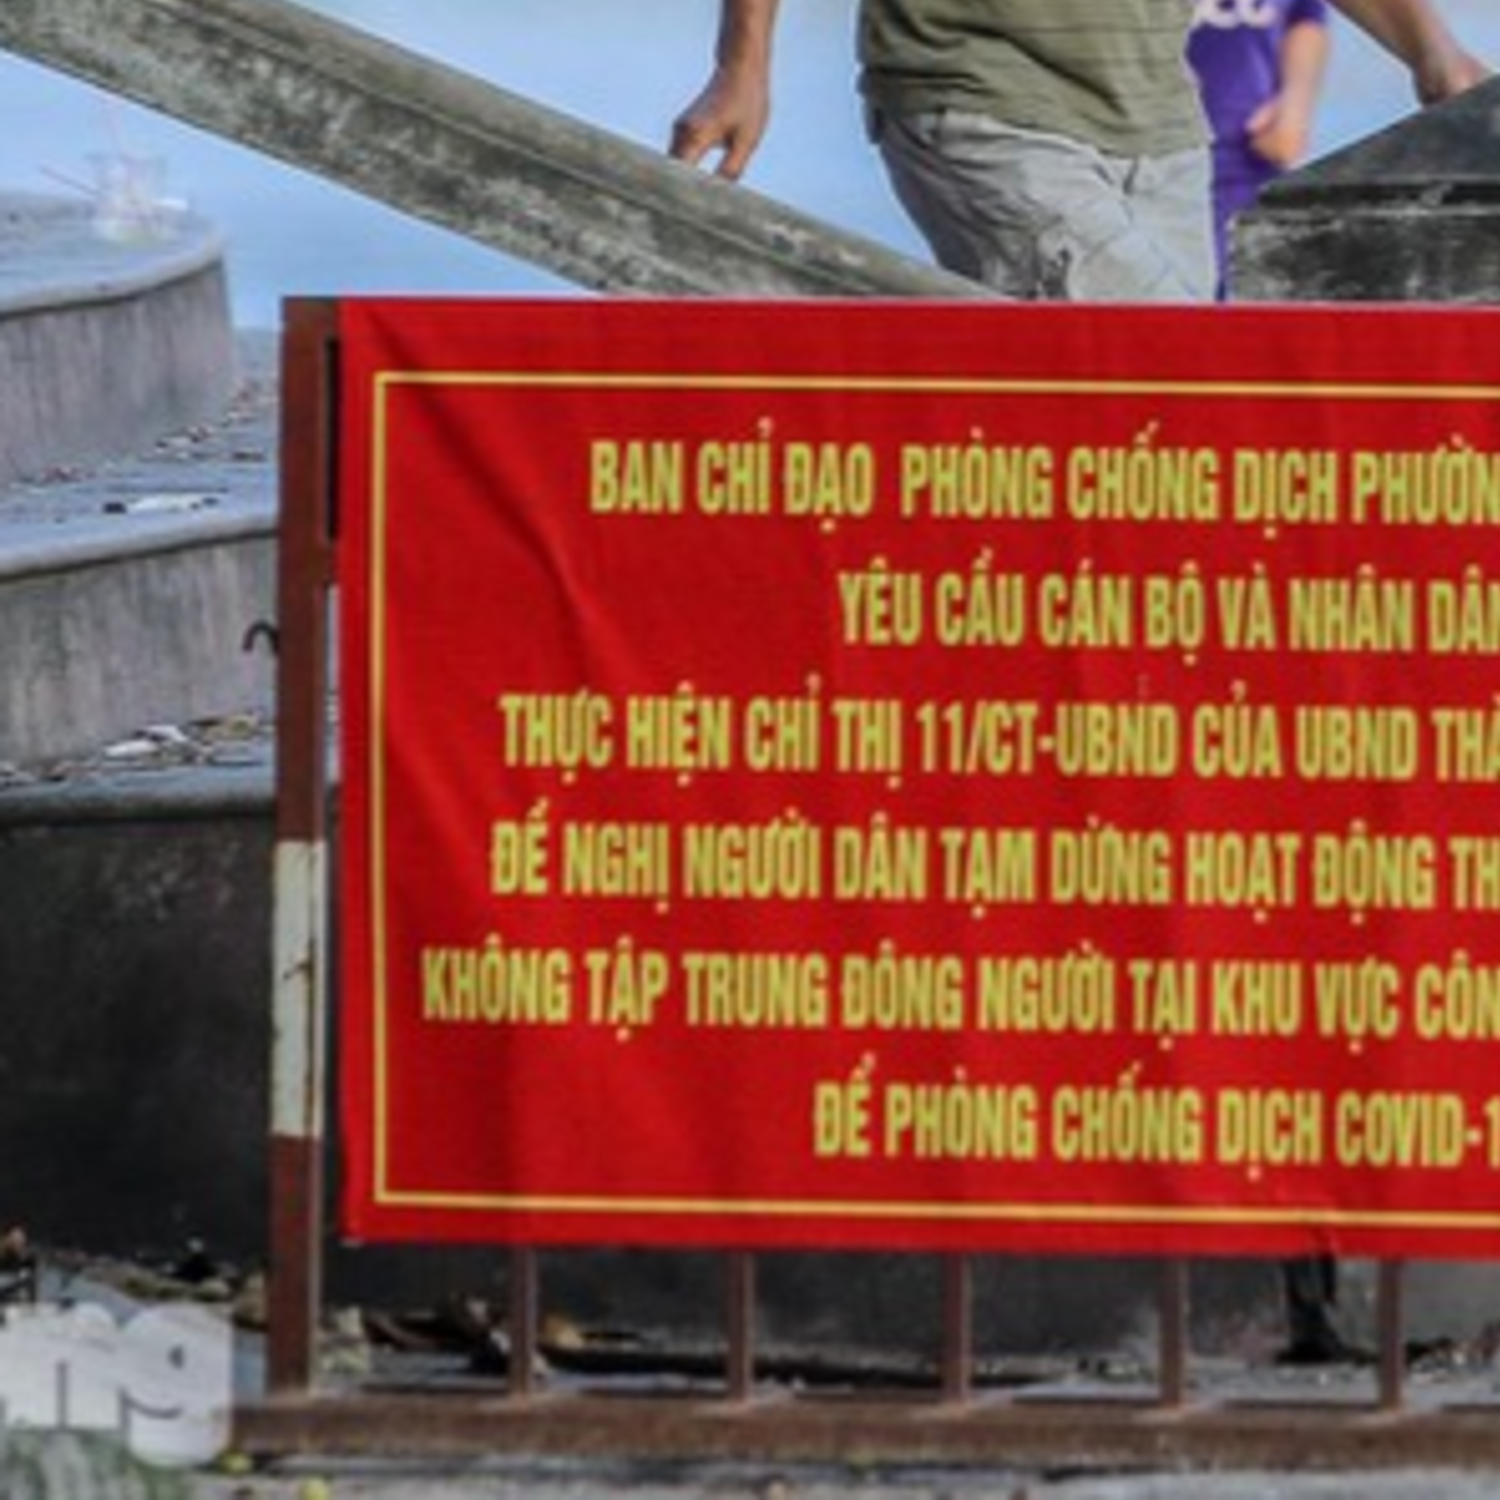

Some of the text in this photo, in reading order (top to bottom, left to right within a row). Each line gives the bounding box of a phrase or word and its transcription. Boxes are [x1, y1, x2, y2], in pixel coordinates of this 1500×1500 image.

[590, 439, 684, 514] BAN
[696, 417, 772, 515] CHỈ
[782, 441, 875, 533] ĐẠO
[900, 428, 1054, 519] PHÒNG
[1066, 422, 1221, 522] CHỐNG
[1232, 448, 1339, 539] DỊCH
[837, 556, 923, 646] YÊU
[1038, 558, 1133, 648] CÁN
[1144, 560, 1206, 666] BỘ
[1216, 562, 1277, 650] VÀ
[1288, 563, 1415, 652] NHÂN
[498, 688, 614, 784] THỰC
[626, 681, 732, 786] HIỆN
[744, 674, 820, 772] CHỈ
[831, 698, 903, 789] THỊ
[916, 700, 1180, 778] 11/CT-UBND
[1191, 680, 1283, 779] CỦA
[1295, 705, 1419, 782] UBND
[562, 821, 670, 913] NGHỊ
[683, 808, 822, 900] NGƯỜI
[833, 811, 928, 901] DÂN
[939, 827, 1037, 919] TẠM
[1050, 816, 1173, 905] DỪNG
[1184, 830, 1302, 923] HOẠT
[1311, 819, 1437, 925] ĐỘNG
[422, 932, 573, 1025] KHÔNG
[584, 935, 670, 1041] TẬP
[681, 951, 830, 1028] TRUNG
[840, 939, 965, 1031] ĐÔNG
[976, 940, 1116, 1033] NGƯỜI
[1127, 958, 1199, 1050] TẠI
[1210, 960, 1303, 1037] KHU
[1314, 957, 1401, 1053] VỰC
[812, 1053, 875, 1158] ĐỂ
[884, 1067, 1039, 1161] PHÒNG
[1051, 1063, 1205, 1164] CHỐNG
[1215, 1087, 1323, 1180] DỊCH
